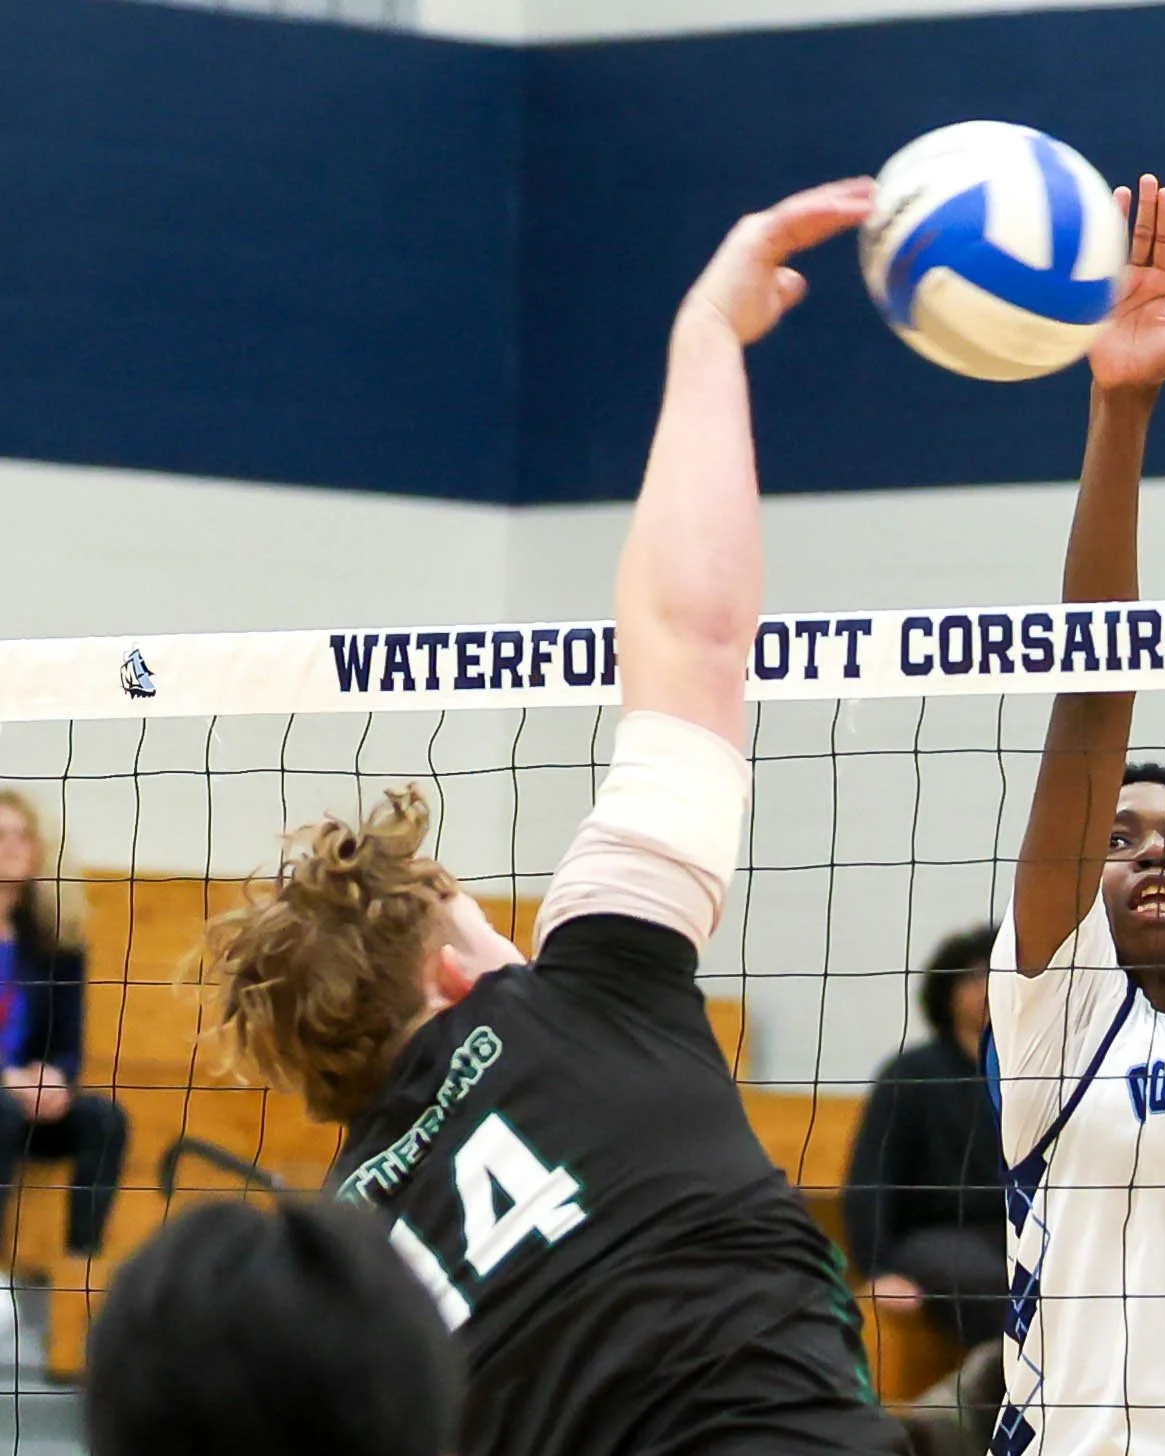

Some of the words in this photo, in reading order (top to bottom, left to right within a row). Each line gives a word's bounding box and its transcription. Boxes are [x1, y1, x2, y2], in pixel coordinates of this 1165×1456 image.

[329, 626, 616, 692] WATERFO
[746, 618, 872, 680] OTT
[388, 1111, 590, 1333] 14
